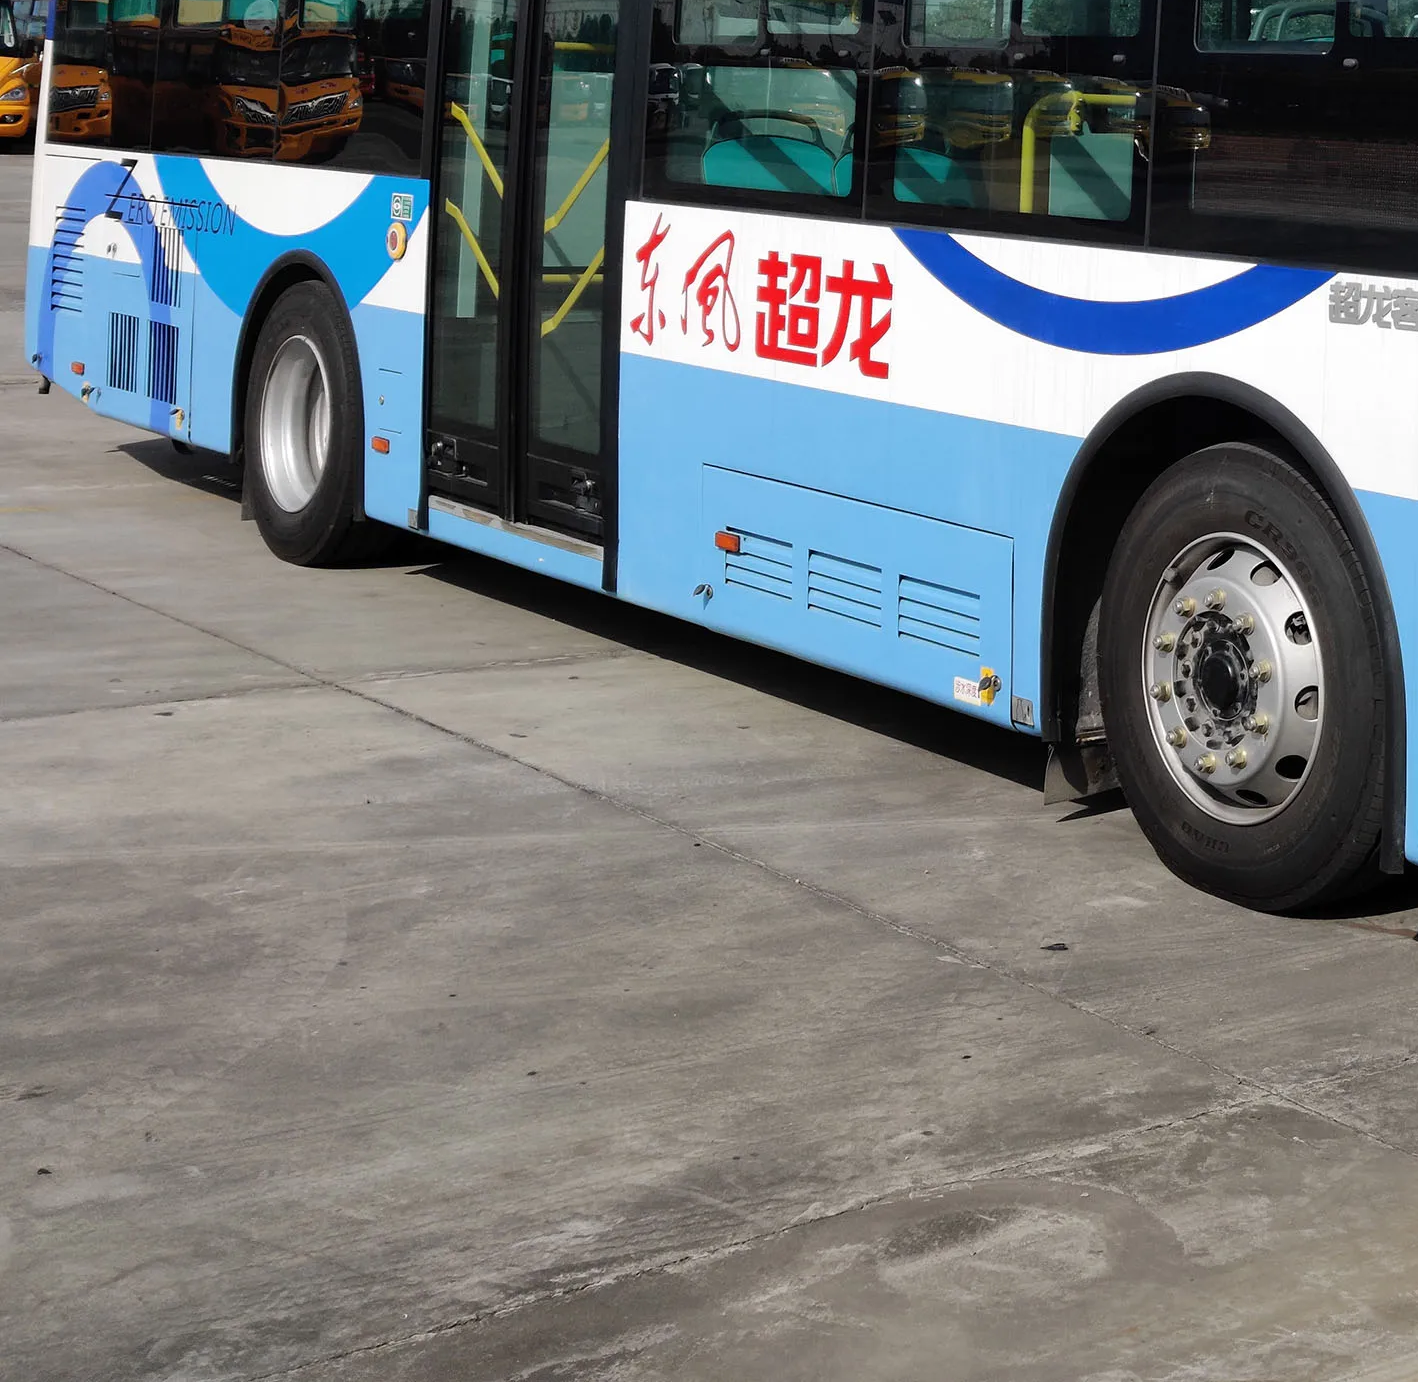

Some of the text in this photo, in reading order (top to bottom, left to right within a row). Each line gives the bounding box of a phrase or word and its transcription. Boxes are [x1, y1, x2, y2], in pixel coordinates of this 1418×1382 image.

[160, 196, 237, 236] EMISSION
[629, 212, 893, 380] 东风超龙
